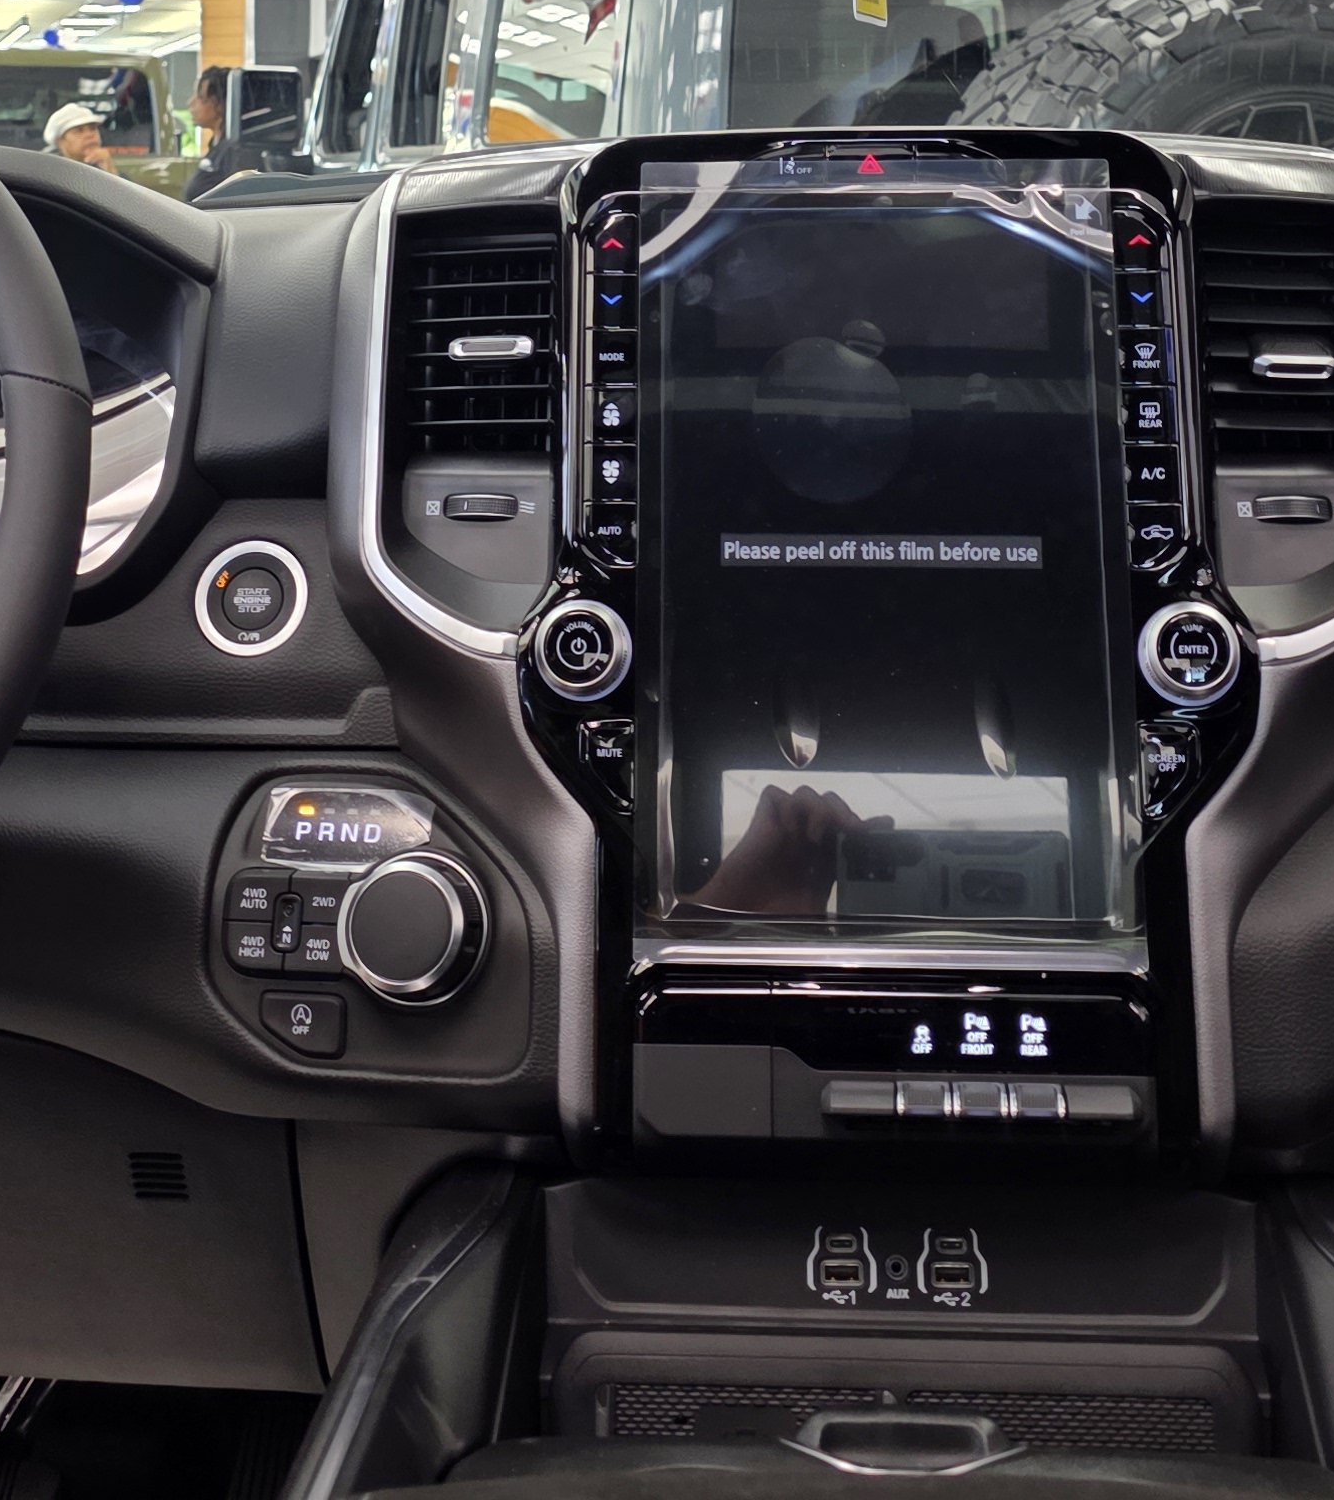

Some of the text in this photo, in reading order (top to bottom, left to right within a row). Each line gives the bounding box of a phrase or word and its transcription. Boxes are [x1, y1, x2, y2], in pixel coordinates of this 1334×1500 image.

[599, 353, 624, 362] MODE
[1133, 360, 1161, 369] FRONT
[1138, 420, 1163, 429] REAR
[1141, 467, 1166, 480] A/C
[597, 525, 622, 535] AUTO
[723, 541, 1038, 565] Please peel off this film before use
[236, 587, 270, 596] START
[237, 605, 266, 613] STOP
[563, 621, 595, 633] VOLUME
[1181, 623, 1204, 633] TUNE
[1178, 644, 1209, 655] ENTER
[596, 747, 624, 757] MUTE
[1148, 753, 1186, 763] SCREEN
[1158, 762, 1177, 772] OFF
[242, 887, 267, 899] 4WD
[240, 898, 268, 909] AUTO
[312, 896, 336, 907] 2WD
[240, 936, 265, 946] 4WD
[282, 933, 292, 944] N
[306, 939, 331, 950] 4WD
[238, 946, 265, 958] HIGH
[306, 950, 330, 961] LOW
[292, 1025, 309, 1035] OFF
[967, 1032, 988, 1043] OFF
[911, 1043, 934, 1054] OFF
[960, 1043, 995, 1055] FRONT
[886, 1288, 910, 1299] AUX
[960, 1292, 972, 1306] 2
